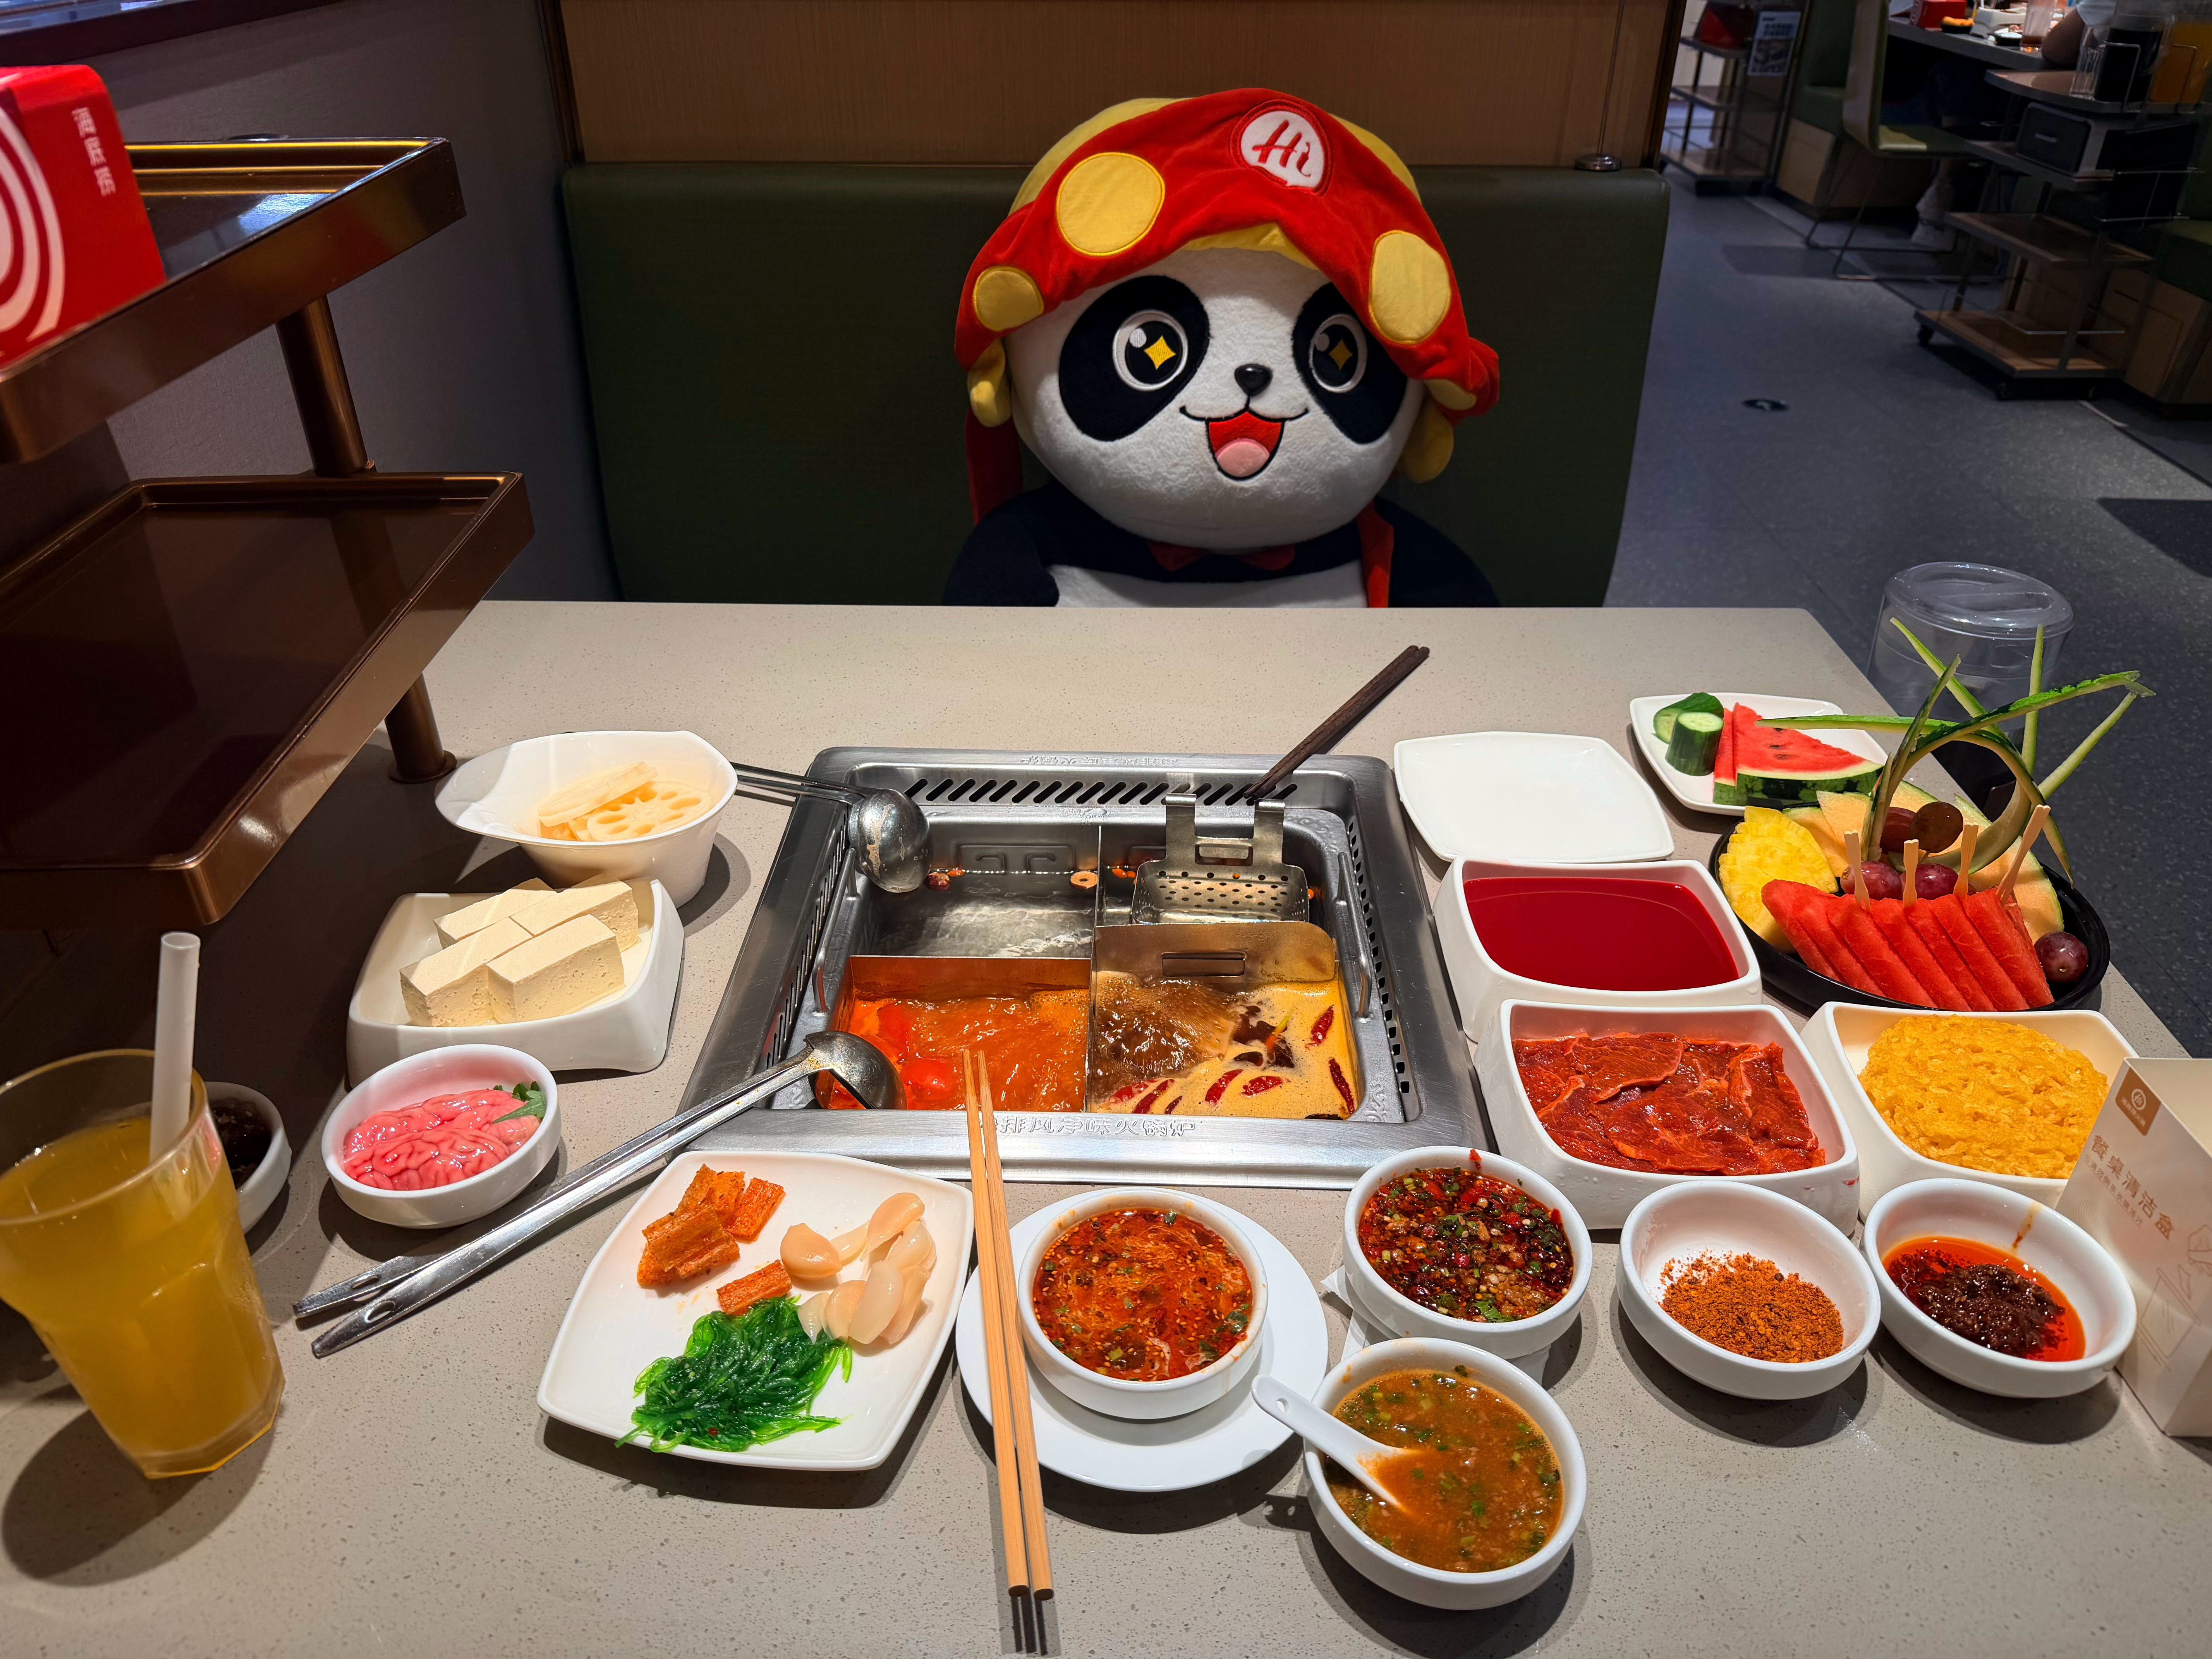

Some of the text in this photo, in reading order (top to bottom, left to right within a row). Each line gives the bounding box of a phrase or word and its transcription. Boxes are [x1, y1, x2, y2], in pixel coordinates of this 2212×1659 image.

[1252, 120, 1312, 178] Hi
[2092, 1135, 2174, 1240] 餐桌清洁盒
